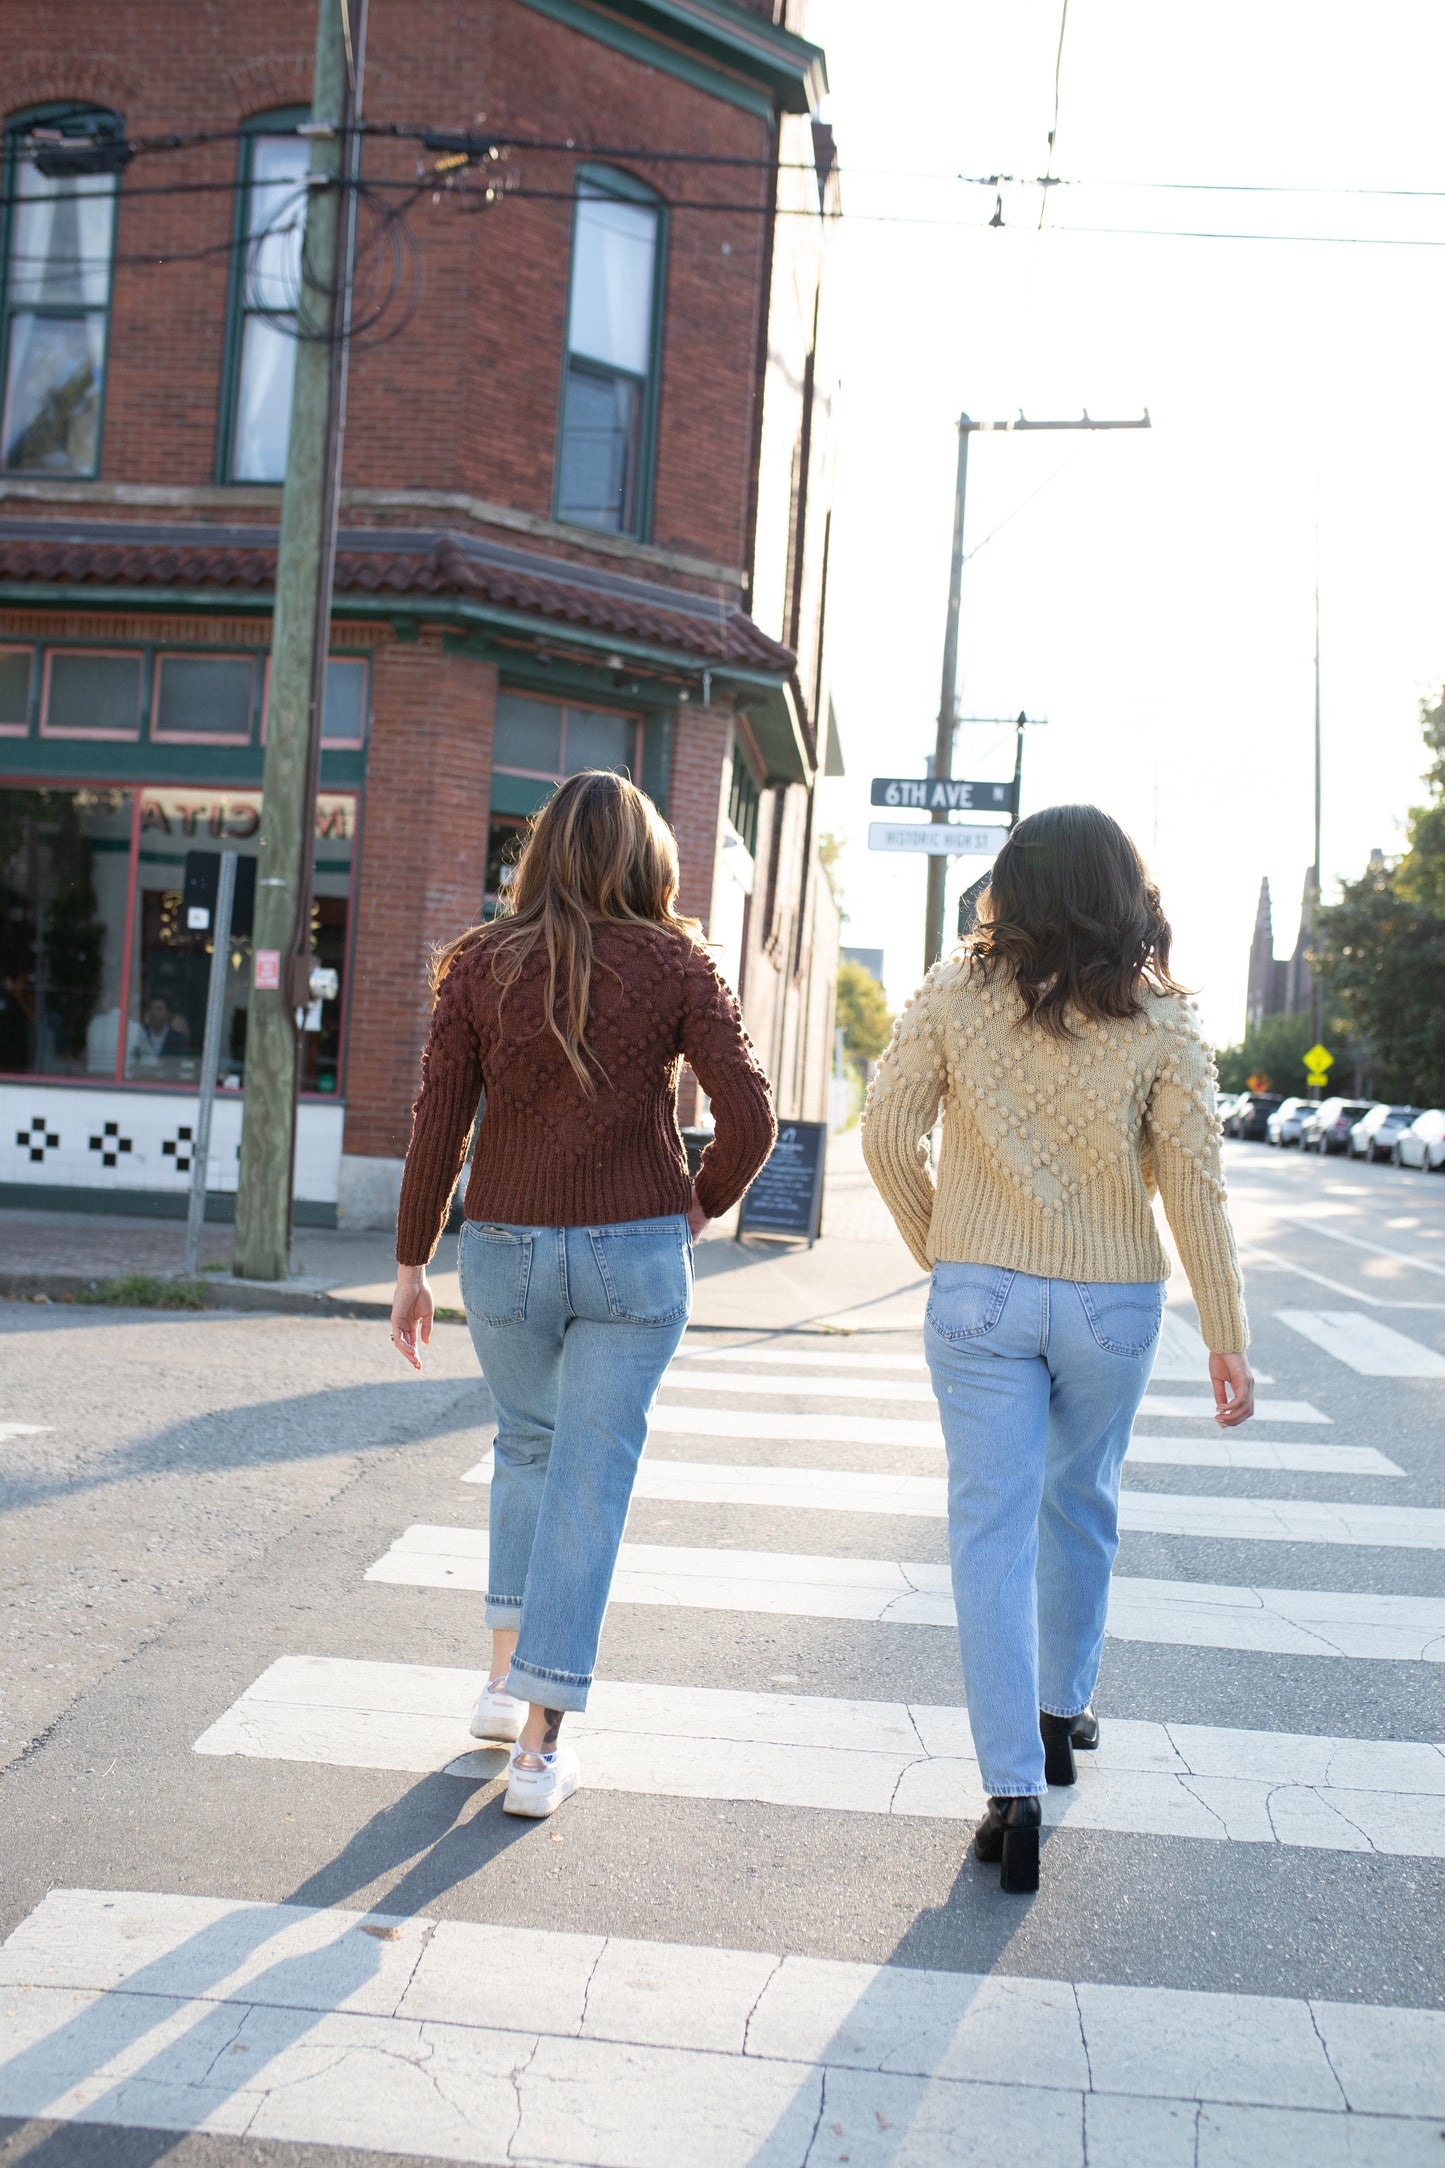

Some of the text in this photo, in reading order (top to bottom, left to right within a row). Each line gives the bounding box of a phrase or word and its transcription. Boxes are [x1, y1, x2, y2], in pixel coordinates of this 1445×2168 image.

[885, 782, 927, 806] 6TH
[930, 783, 974, 808] AVE
[885, 829, 989, 850] HISTORIC HIGH ST
